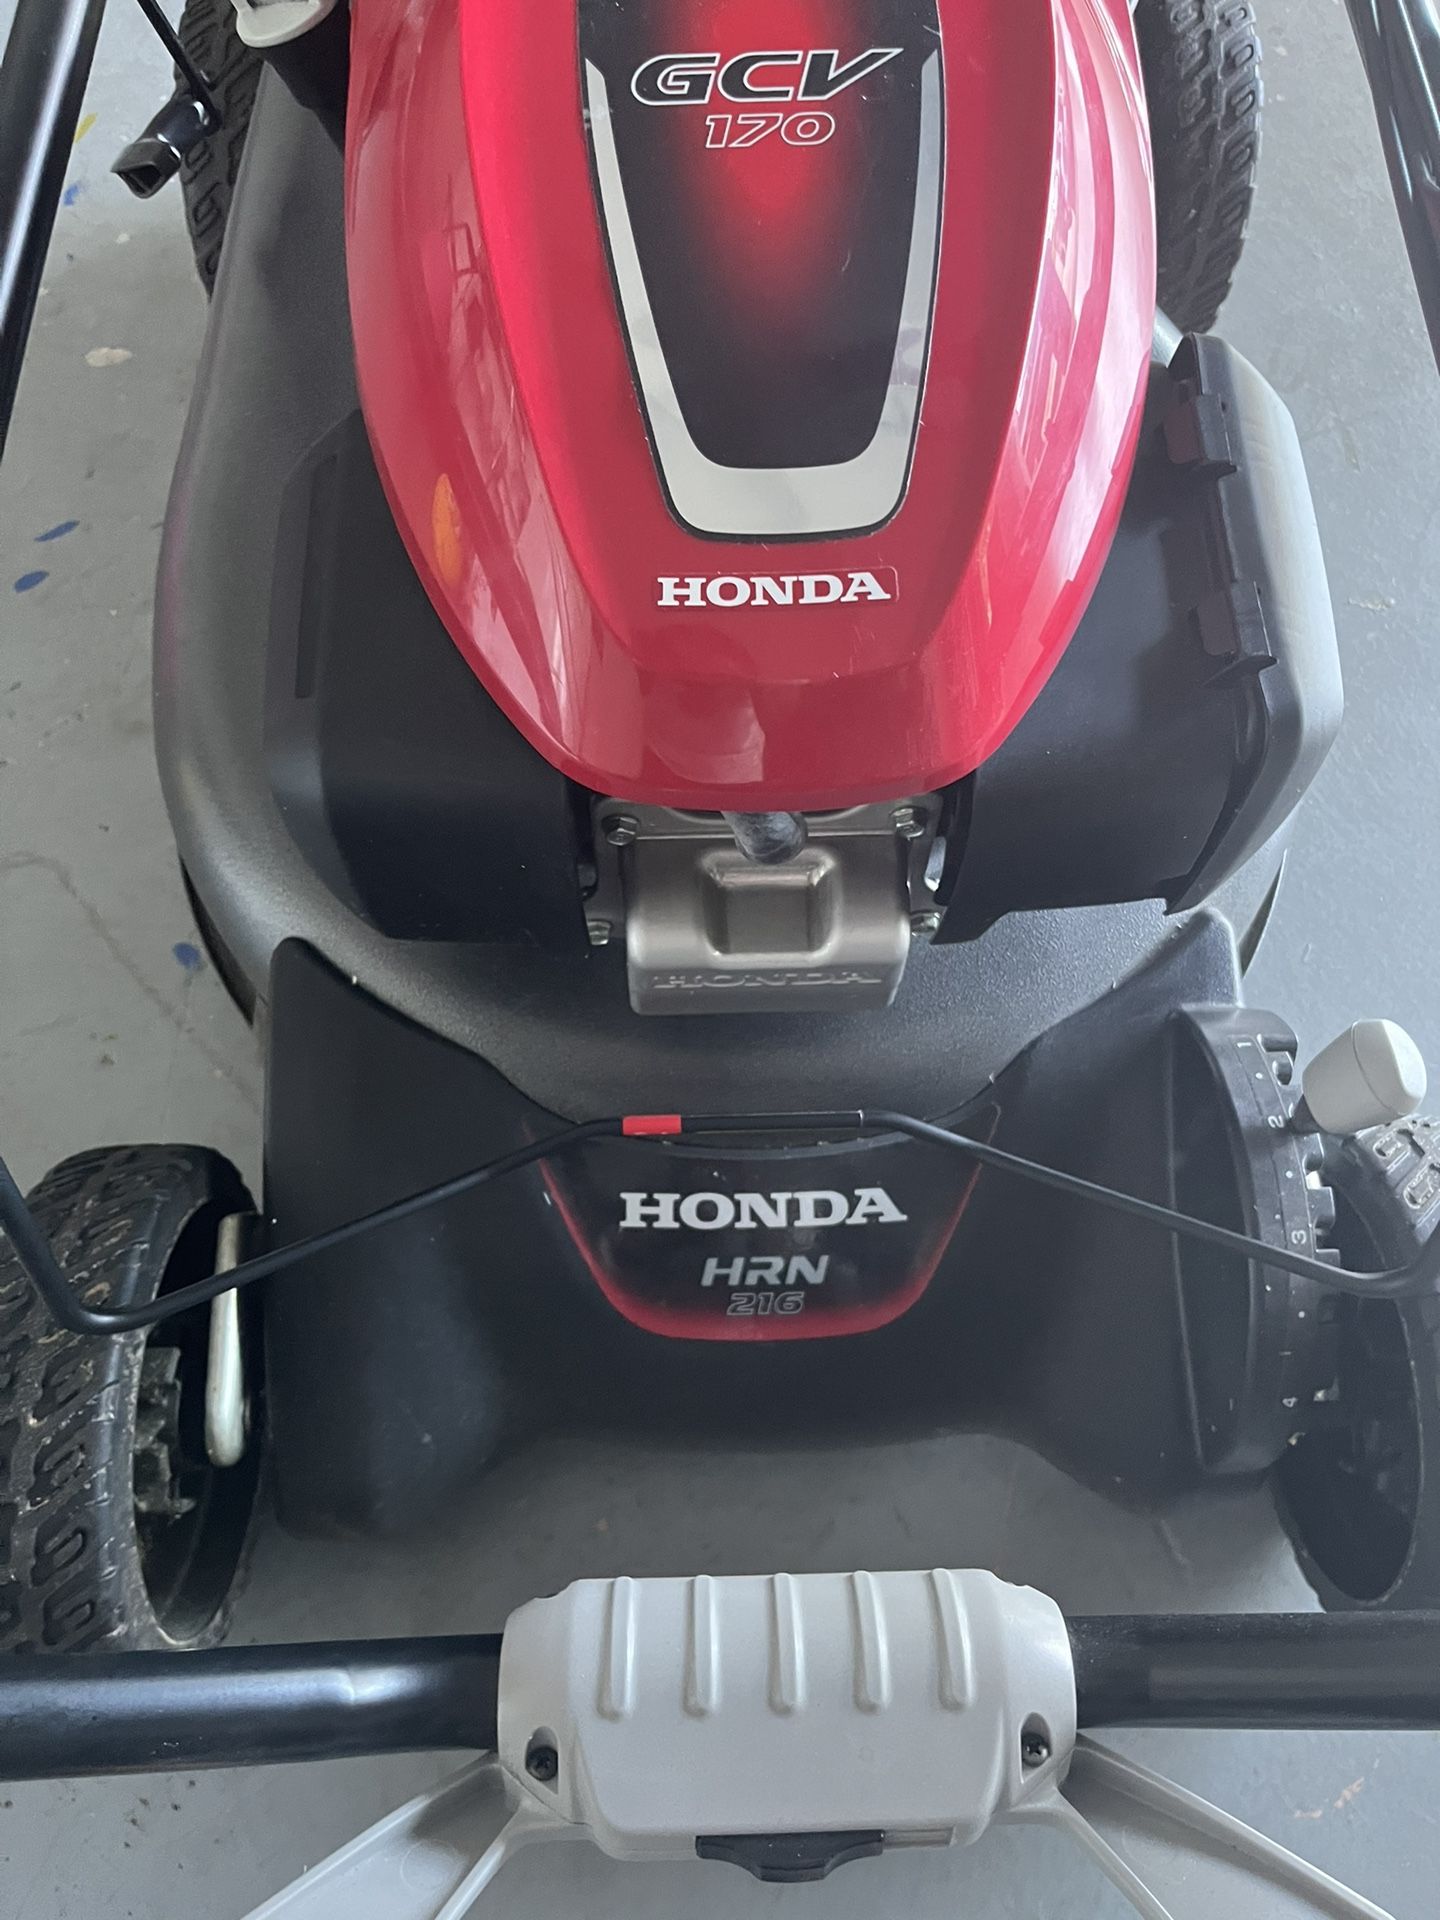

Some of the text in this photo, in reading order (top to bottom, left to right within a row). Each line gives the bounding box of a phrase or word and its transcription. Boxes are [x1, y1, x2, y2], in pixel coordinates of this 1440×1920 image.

[631, 48, 904, 105] GCV
[705, 111, 835, 148] 170
[657, 571, 891, 607] HONDA
[653, 971, 882, 989] HONDA
[1267, 1115, 1284, 1128] 2
[619, 1187, 908, 1229] HONDA
[1291, 1229, 1307, 1245] 3
[701, 1255, 829, 1286] HRN
[726, 1291, 805, 1316] 216
[1282, 1397, 1298, 1408] 4
